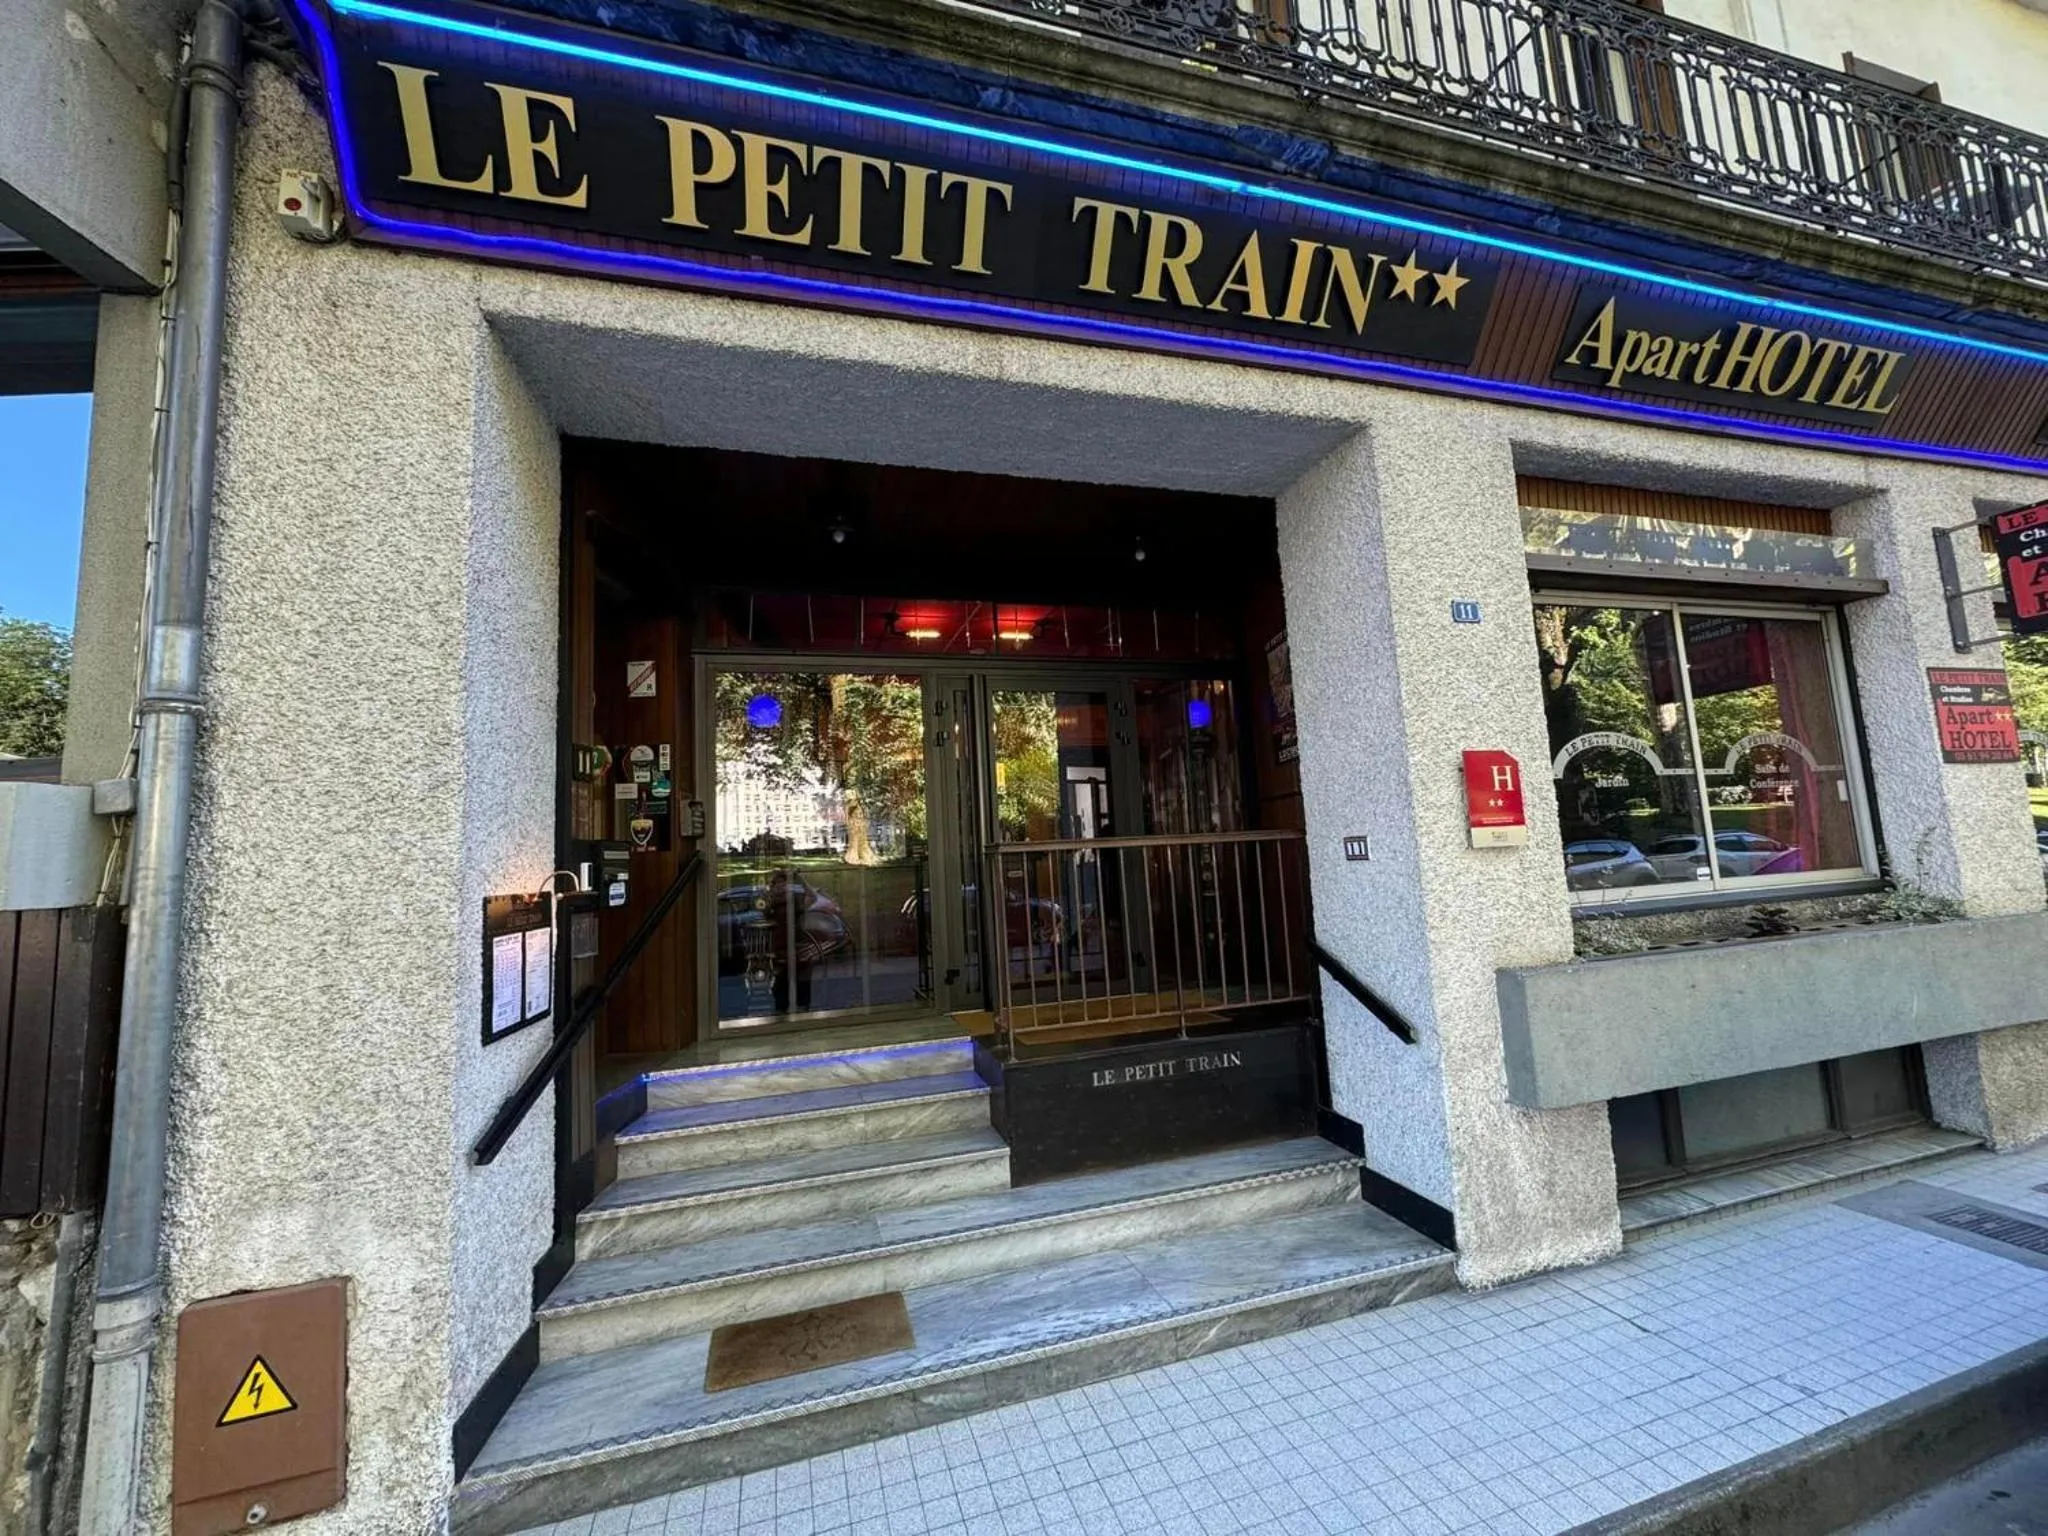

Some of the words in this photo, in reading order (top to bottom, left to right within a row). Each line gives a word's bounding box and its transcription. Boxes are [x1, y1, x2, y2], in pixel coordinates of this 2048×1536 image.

[377, 60, 589, 209] LE
[654, 114, 1014, 276] PETIT
[1071, 196, 1389, 337] TRAIN
[1564, 295, 1907, 416] ApartHOTEL
[2006, 511, 2039, 530] LE
[2019, 527, 2048, 543] Ch
[2021, 544, 2043, 557] et
[2028, 560, 2048, 587] A
[1459, 604, 1475, 620] 11
[1946, 706, 1996, 730] Apart
[1948, 730, 2012, 749] HOTEL
[1490, 765, 1515, 792] H
[1594, 775, 1630, 789] Jardin
[1092, 1069, 1116, 1087] LE
[1125, 1059, 1177, 1082] PETIT
[1185, 1050, 1243, 1073] TRAIN
